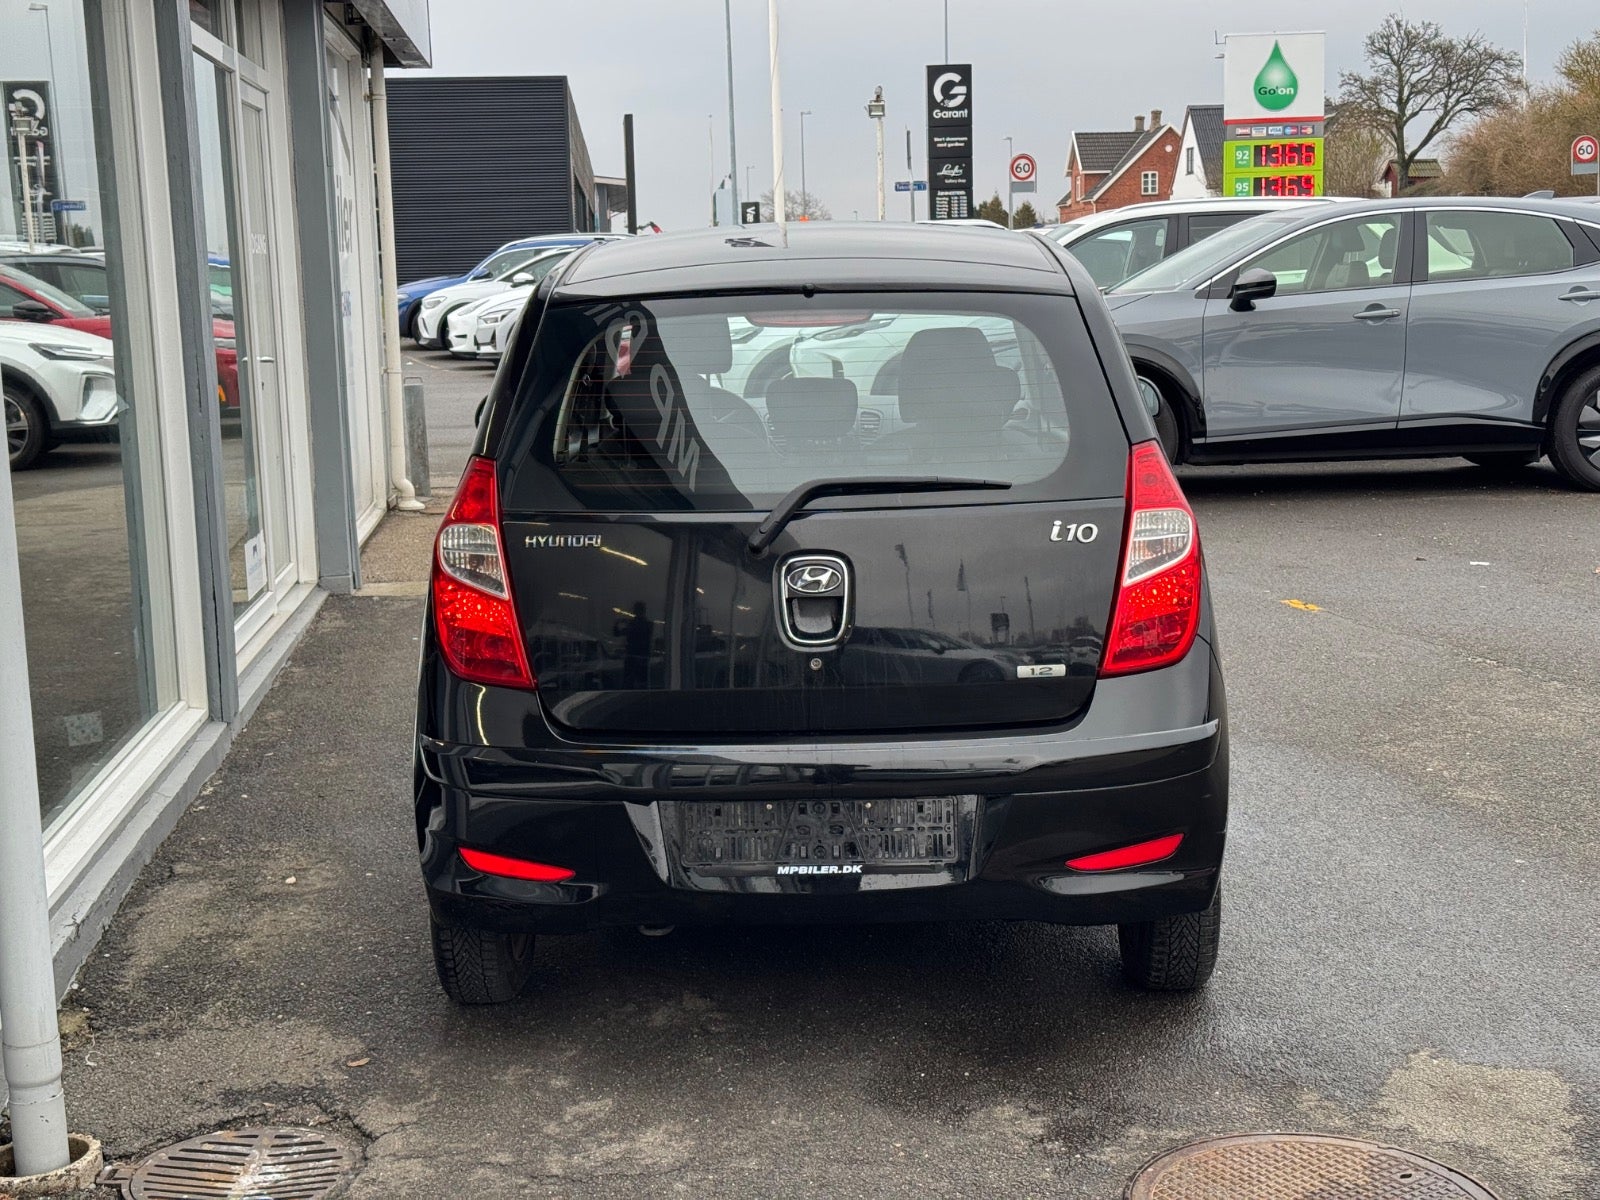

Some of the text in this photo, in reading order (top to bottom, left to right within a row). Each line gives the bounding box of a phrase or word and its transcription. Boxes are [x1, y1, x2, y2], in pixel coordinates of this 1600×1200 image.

[933, 108, 968, 119] Garant
[1578, 144, 1593, 155] 60
[1236, 151, 1249, 160] 92
[1015, 162, 1030, 174] 60
[1236, 182, 1249, 192] 95
[1051, 520, 1098, 543] i10
[525, 535, 601, 548] HYUNDAI
[1030, 666, 1053, 676] 1.2
[777, 864, 862, 875] MPBILER.DK
